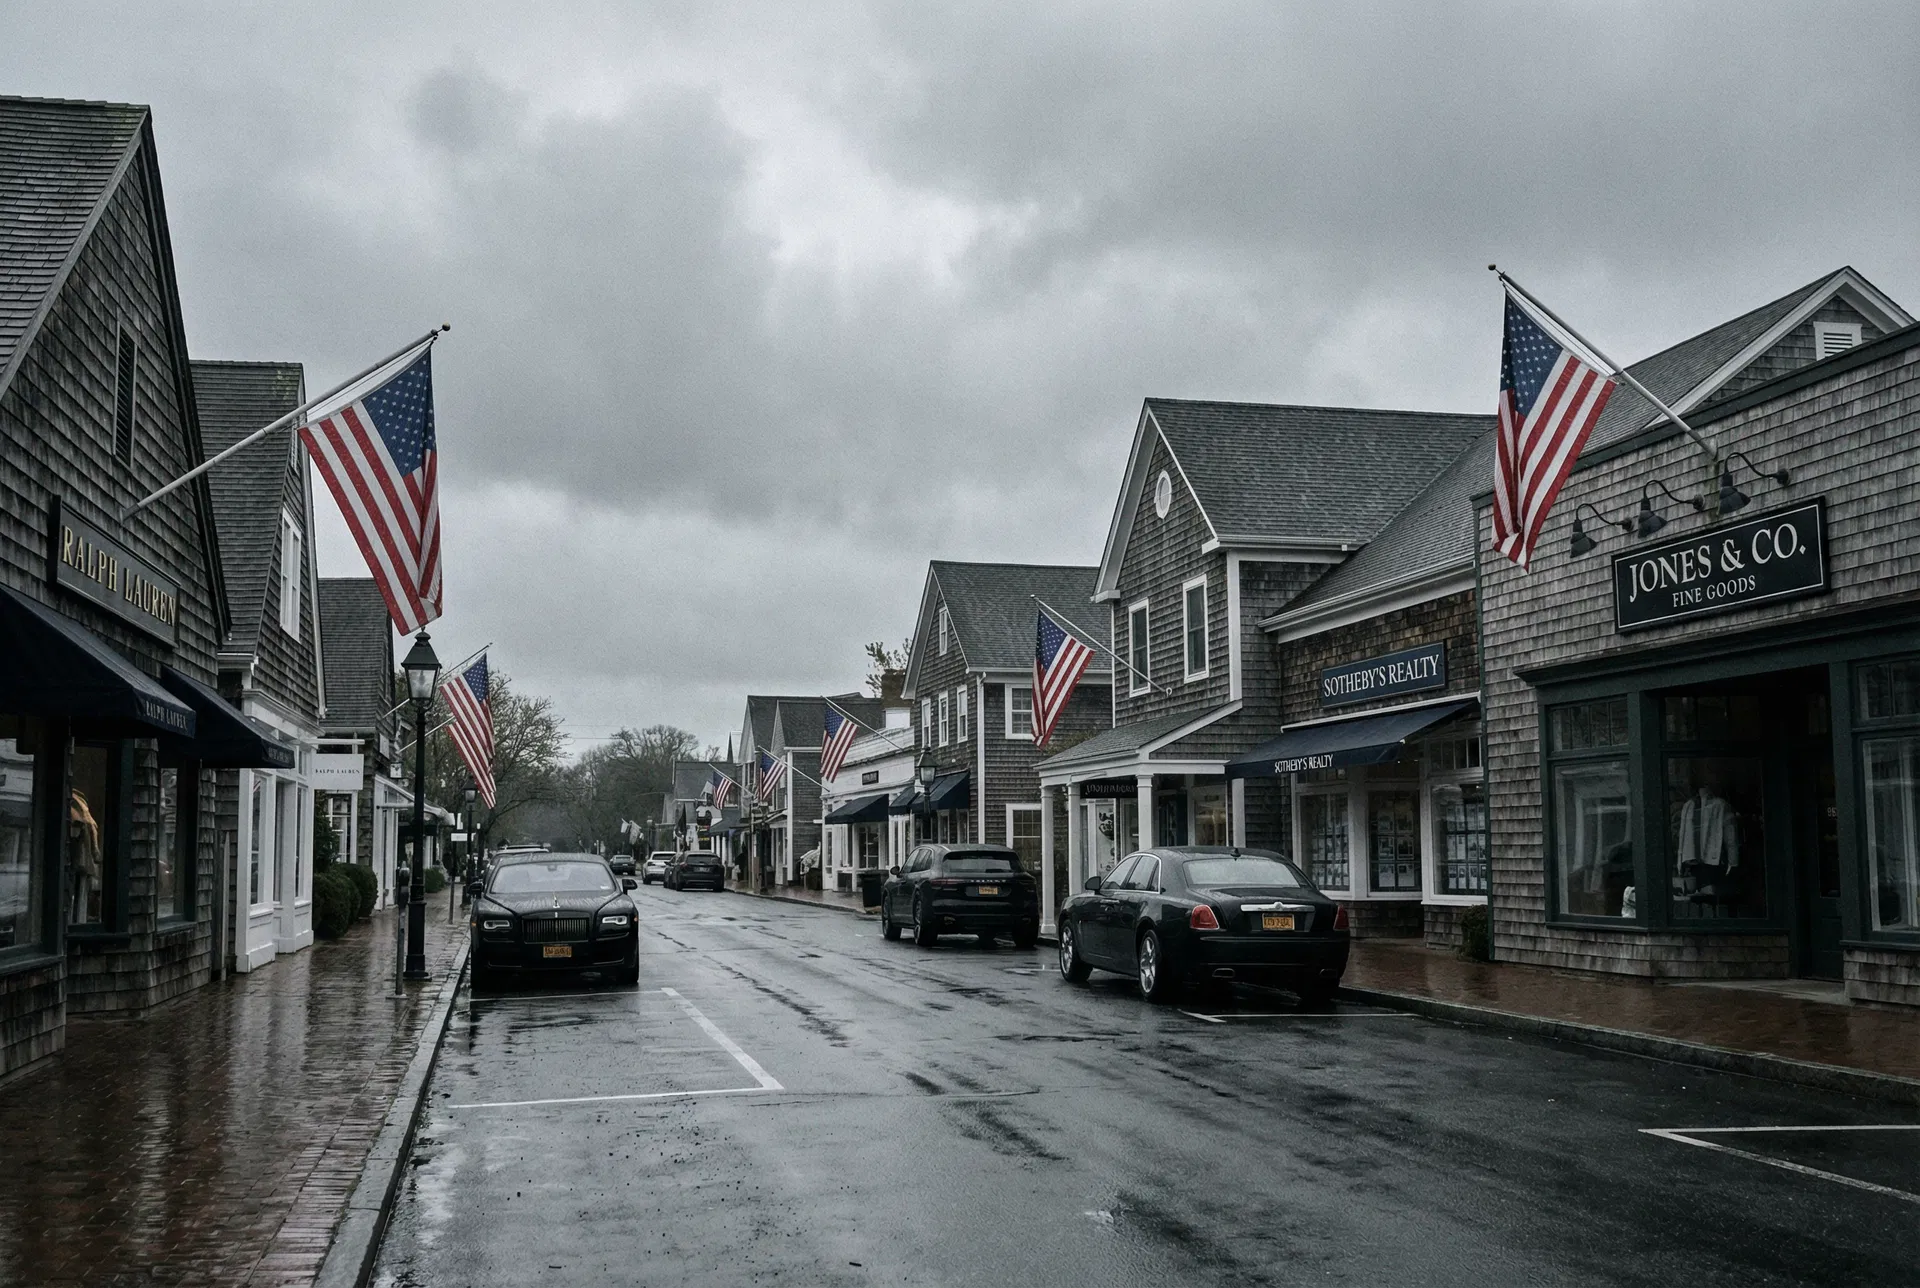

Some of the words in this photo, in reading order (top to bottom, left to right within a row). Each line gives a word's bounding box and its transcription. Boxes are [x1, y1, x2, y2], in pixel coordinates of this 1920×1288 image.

[62, 525, 118, 592] RALPH
[1629, 545, 1712, 603] JONES
[1720, 538, 1746, 572] &
[1751, 523, 1807, 565] CO.
[1672, 587, 1703, 608] FINE
[1706, 575, 1756, 600] GOODS
[1323, 665, 1386, 698] SOTHEBY'S
[1387, 654, 1440, 685] REALTY
[1308, 753, 1334, 769] REALTY
